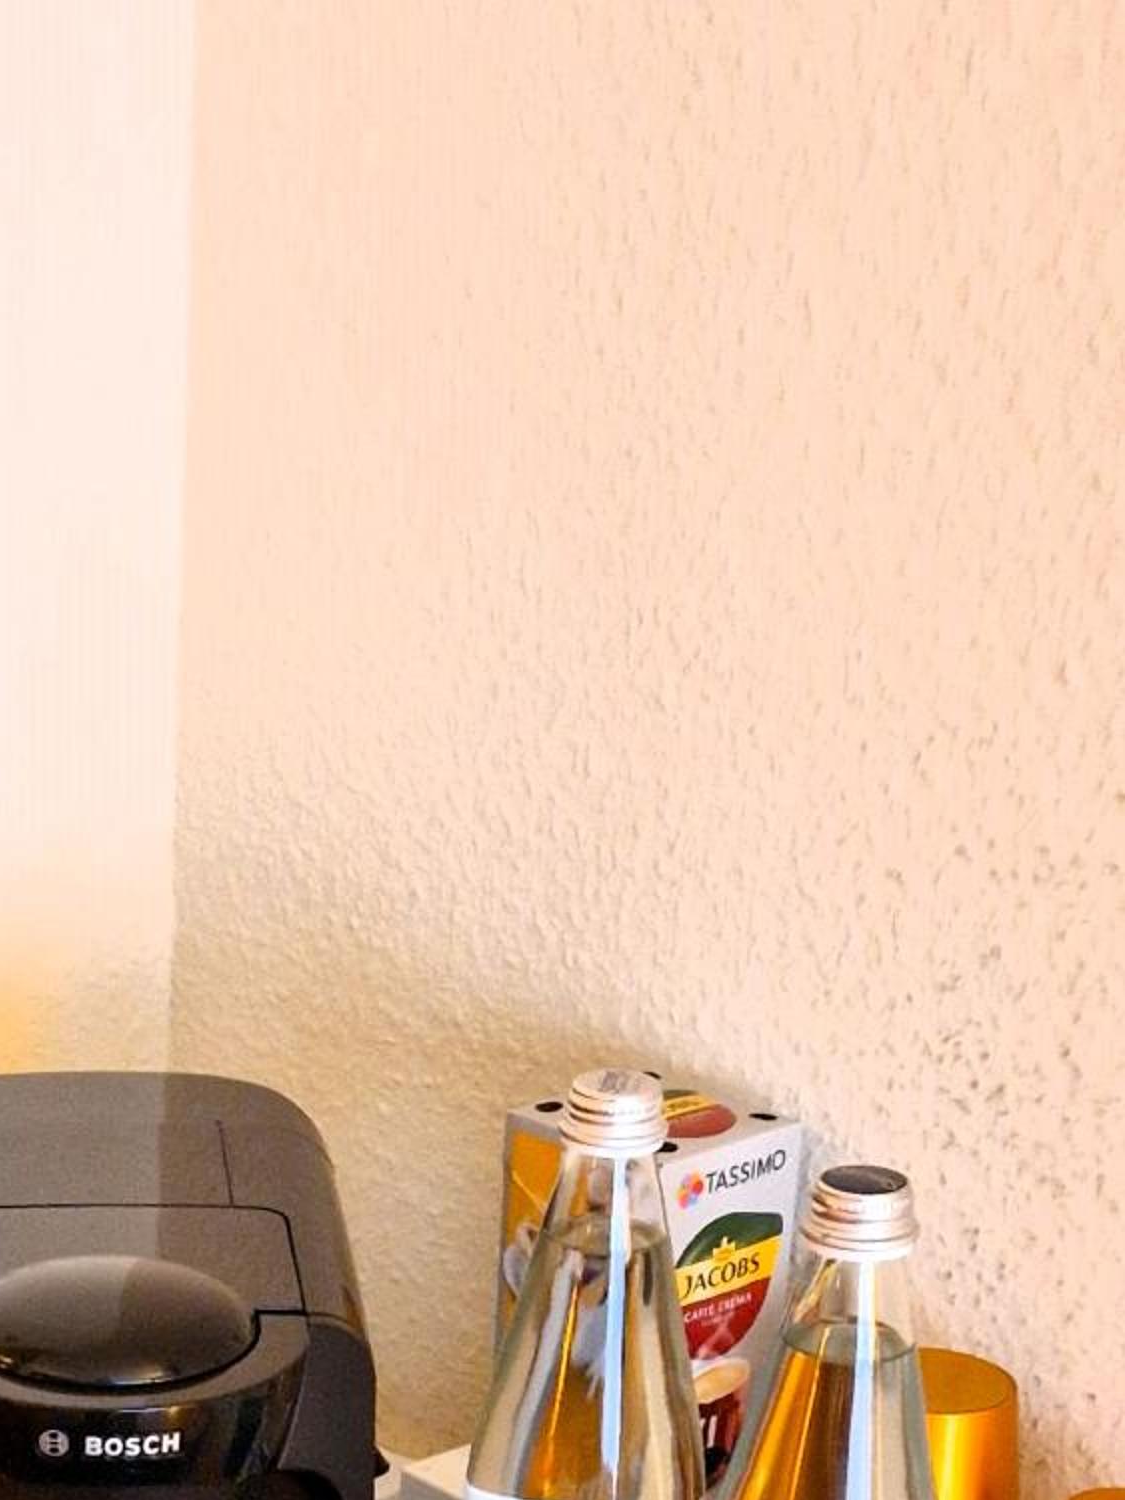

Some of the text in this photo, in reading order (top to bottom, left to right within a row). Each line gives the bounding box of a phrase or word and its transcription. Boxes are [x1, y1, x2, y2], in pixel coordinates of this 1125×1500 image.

[705, 1149, 787, 1194] TASSIMO
[681, 1252, 760, 1300] JACOBS
[84, 1432, 181, 1457] BOSCH
